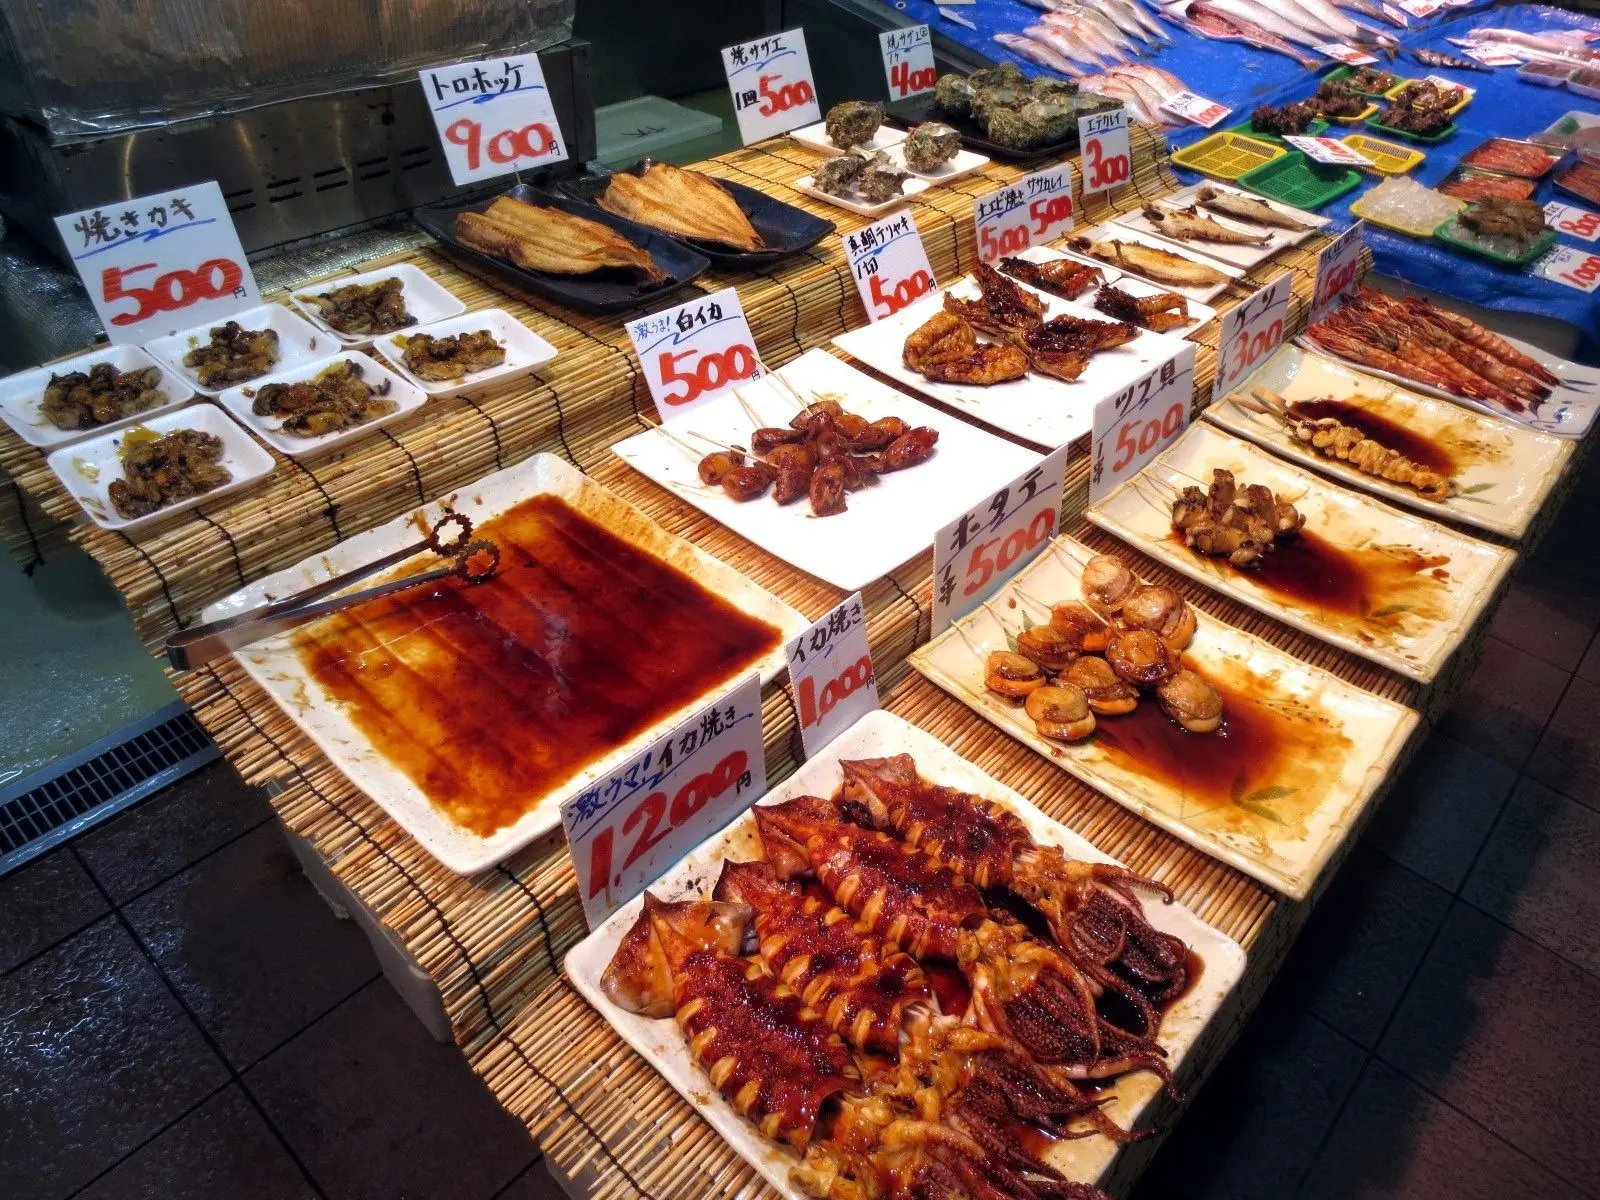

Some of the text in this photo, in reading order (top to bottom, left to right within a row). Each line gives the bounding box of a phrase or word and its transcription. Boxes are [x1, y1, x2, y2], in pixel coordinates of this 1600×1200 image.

[430, 61, 525, 101] トロホッケ
[891, 61, 937, 97] 400
[444, 117, 561, 171] 900円
[74, 198, 197, 248] 焼きカキ
[847, 215, 910, 257] 真鯛テリヤキ
[101, 257, 248, 327] 500円
[675, 301, 723, 334] 白イカ
[868, 268, 938, 321] 500円
[658, 342, 762, 407] 500円
[1114, 357, 1177, 417] ツブ貝
[949, 465, 1045, 551] ホタテ
[790, 602, 863, 664] イカ焼き
[798, 654, 875, 730] 1,000円
[657, 705, 746, 769] イカ焼き
